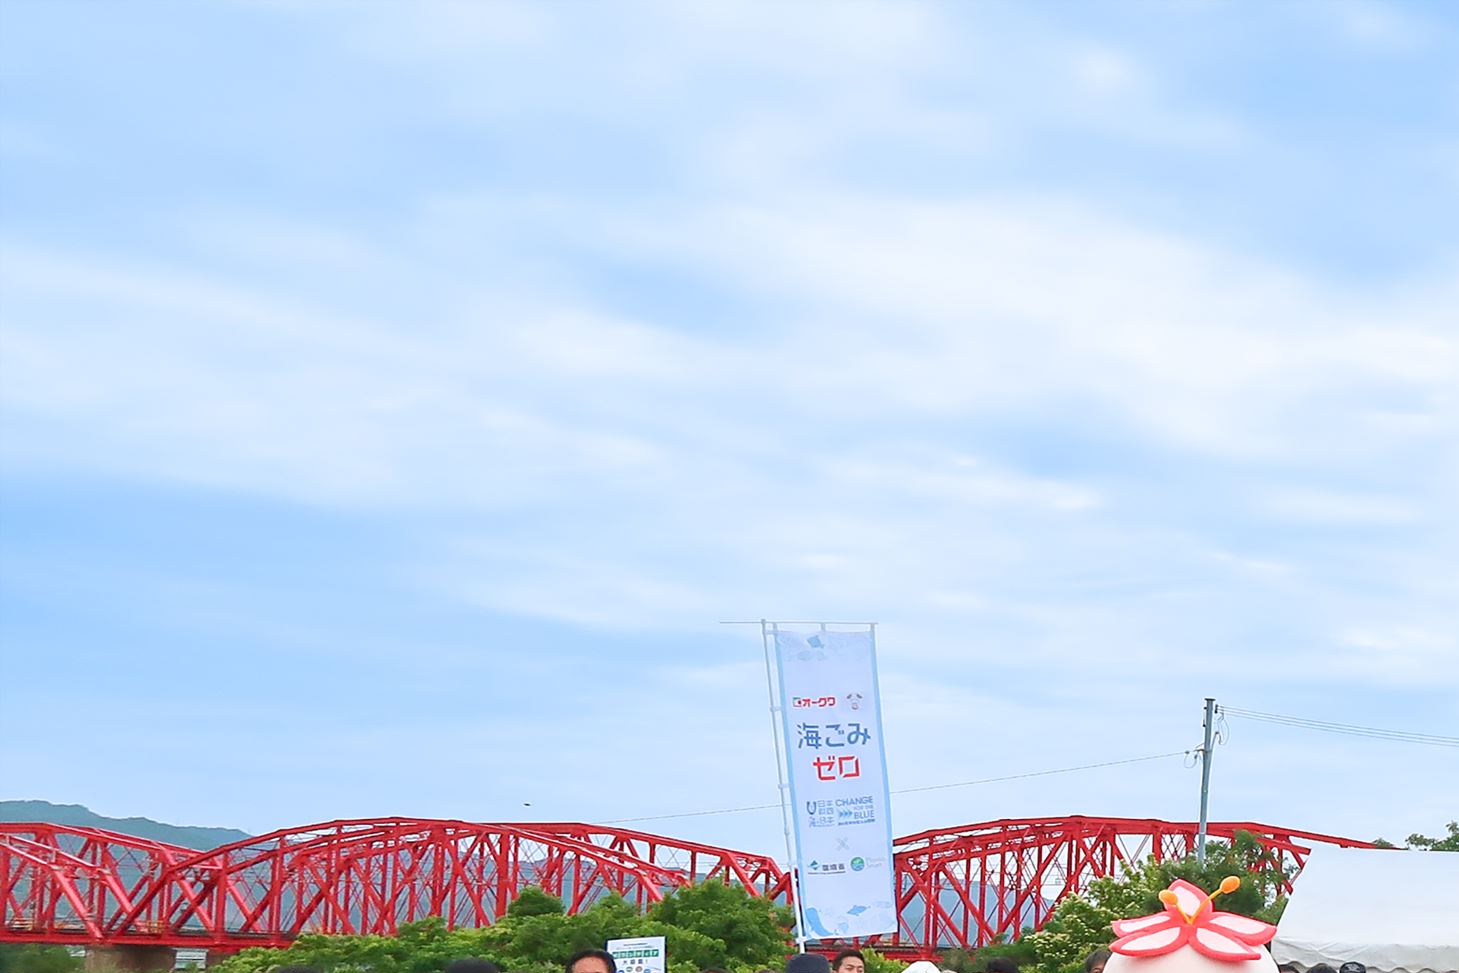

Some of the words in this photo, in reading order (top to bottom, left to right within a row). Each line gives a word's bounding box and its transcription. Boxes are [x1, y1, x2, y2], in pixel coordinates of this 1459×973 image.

[797, 722, 871, 750] 海ごみ
[812, 755, 860, 781] ゼロ
[835, 796, 873, 807] CHANGE
